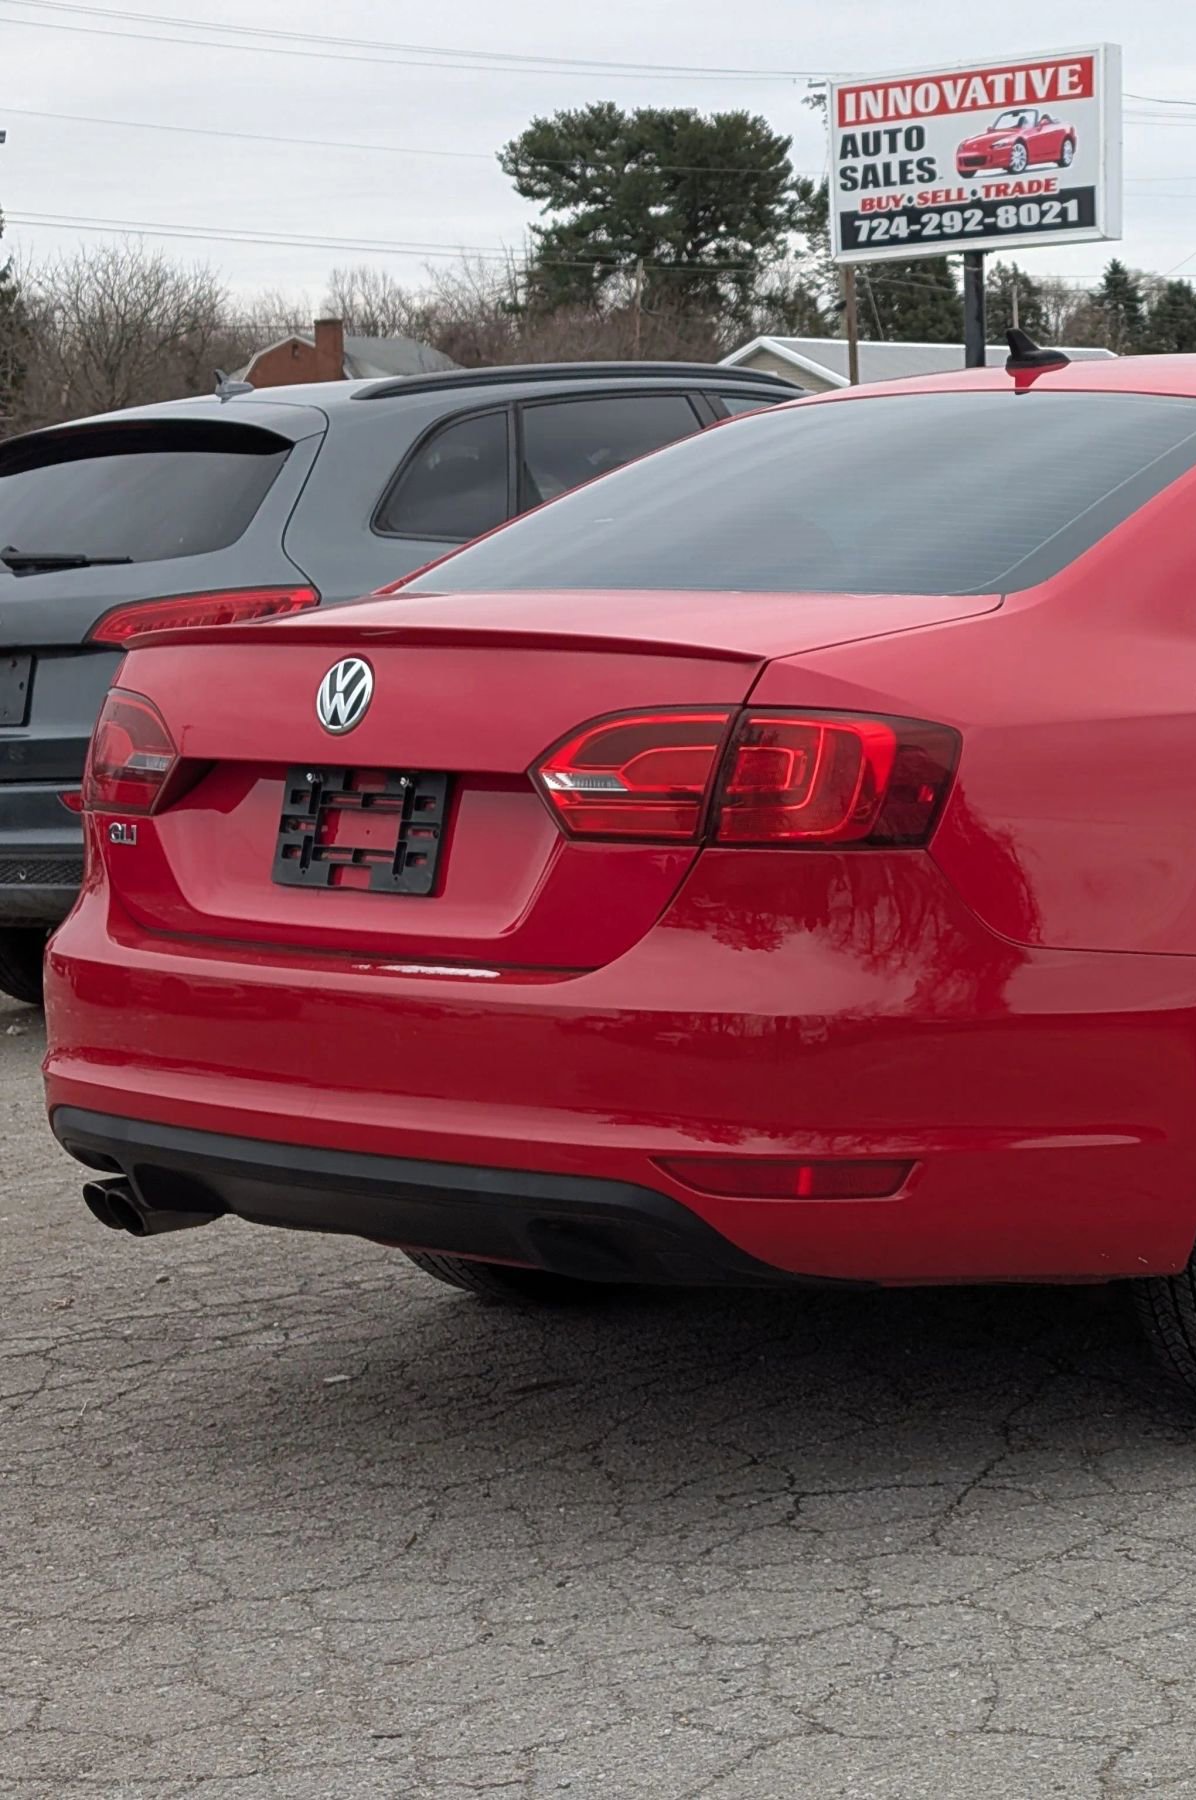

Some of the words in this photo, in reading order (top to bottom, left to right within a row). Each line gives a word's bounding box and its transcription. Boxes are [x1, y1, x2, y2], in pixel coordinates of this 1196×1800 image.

[844, 64, 1083, 123] INNOVATIVE
[839, 125, 925, 160] AUTO
[839, 157, 937, 192] SALES
[860, 194, 905, 214] BUY
[916, 187, 968, 207] SELL
[982, 178, 1058, 200] TRADE
[855, 199, 1080, 242] 724-292-8021
[317, 657, 373, 732] VW
